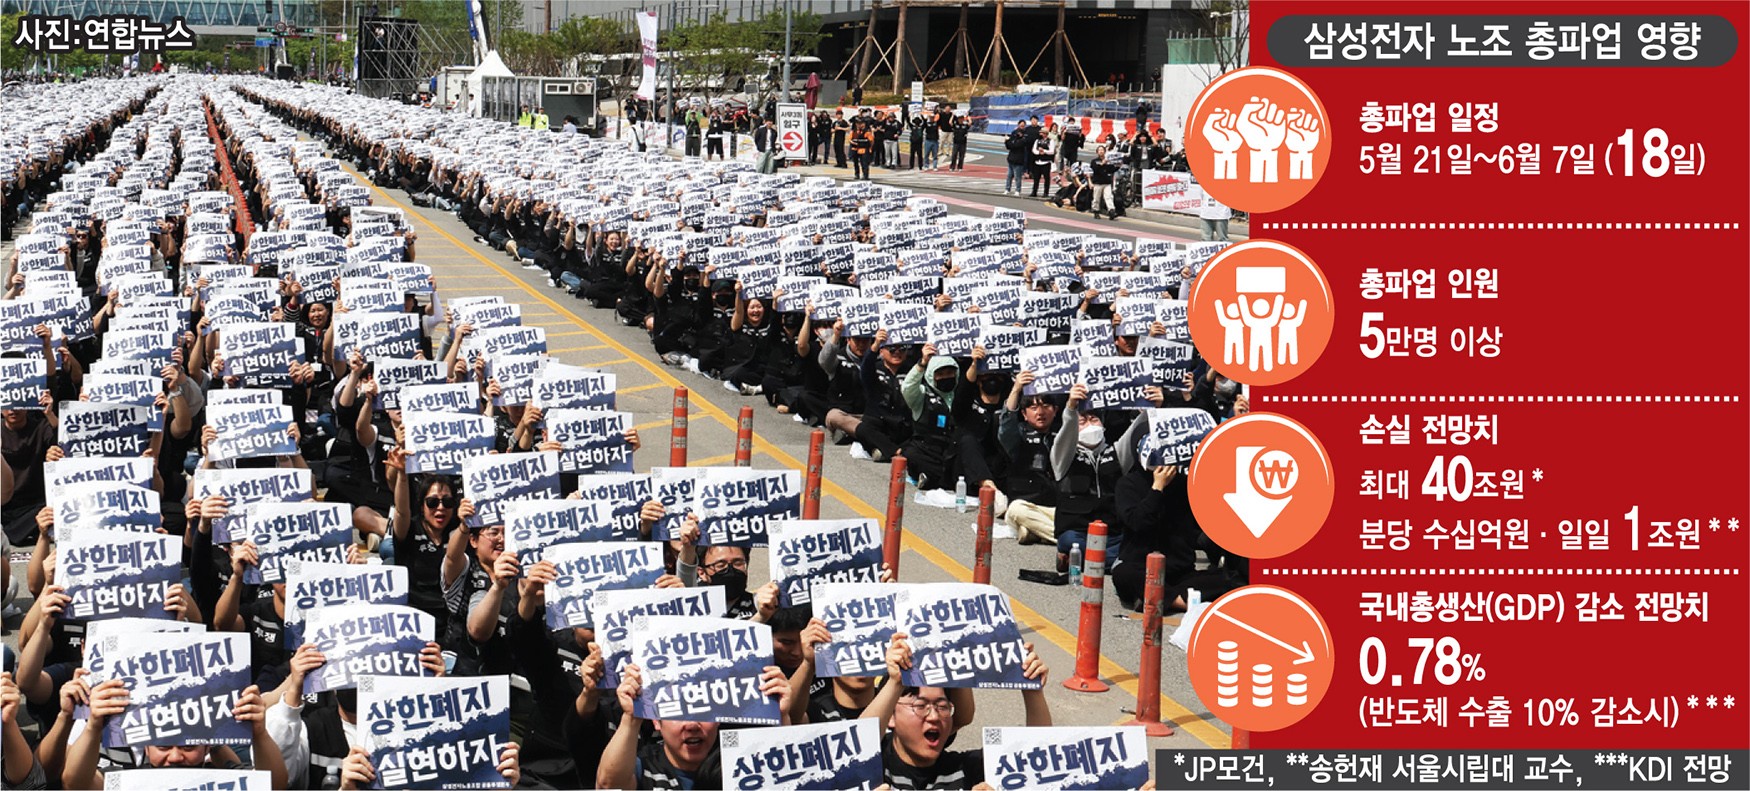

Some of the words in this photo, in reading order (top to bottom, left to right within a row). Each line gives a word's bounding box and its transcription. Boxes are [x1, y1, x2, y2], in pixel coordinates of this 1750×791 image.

[784, 120, 800, 128] 입구
[109, 231, 146, 246] 상한폐지
[250, 233, 287, 249] 상한폐지
[354, 224, 390, 239] 상한폐지
[685, 236, 723, 249] 상한폐지
[296, 249, 334, 265] 상한폐지
[712, 250, 748, 265] 상한폐지
[1085, 239, 1119, 253] 상한폐지
[103, 263, 145, 279] 상한폐지
[857, 253, 894, 270] 상한폐지
[300, 267, 340, 286] 상한폐지
[742, 267, 780, 283] 상한폐지
[891, 278, 934, 296] 상한폐지
[122, 281, 167, 299] 상한폐지
[346, 292, 398, 310] 상한폐지
[976, 287, 1021, 306] 상한폐지
[882, 304, 929, 324] 상한폐지
[1022, 294, 1073, 314] 상한폐지
[224, 325, 286, 352] 상한폐지
[360, 315, 413, 341] 상한폐지
[929, 317, 981, 336] 상한폐지
[107, 333, 164, 358] 상한폐지
[485, 328, 538, 354] 상한폐지
[983, 330, 1038, 350] 상한폐지
[229, 351, 294, 375] 실현하자
[1025, 347, 1082, 372] 상한폐지
[1084, 359, 1145, 385] 상한폐지
[377, 363, 438, 384] 상한폐지
[89, 378, 154, 402] 상한폐지
[538, 376, 606, 401] 상한폐지
[64, 407, 136, 433] 상한폐지
[215, 406, 283, 432] 상한폐지
[411, 418, 484, 444] 상한폐지
[554, 412, 624, 442] 상한폐지
[1155, 413, 1212, 439] 상한폐지
[70, 434, 144, 458] 실현하자
[221, 430, 288, 458] 실현하자
[559, 447, 633, 472] 실현하자
[469, 454, 547, 493] 상한폐지
[701, 473, 789, 509] 상한폐지
[252, 506, 341, 545] 상한폐지
[511, 503, 599, 541] 상한폐지
[63, 538, 167, 575] 상한폐지
[777, 523, 872, 566] 상한폐지
[556, 545, 648, 587] 상한폐지
[293, 570, 393, 609] 상한폐지
[904, 594, 1011, 637] 상한폐지
[313, 612, 421, 651] 상한폐지
[642, 626, 759, 670] 상한폐지
[112, 637, 234, 691] 상한폐지
[920, 639, 1028, 686] 실현하자
[366, 681, 491, 736] 상한폐지
[654, 675, 771, 717] 실현하자
[378, 734, 511, 788] 실현하자
[732, 724, 864, 788] 상한폐지
[1000, 735, 1128, 787] 상한폐지
